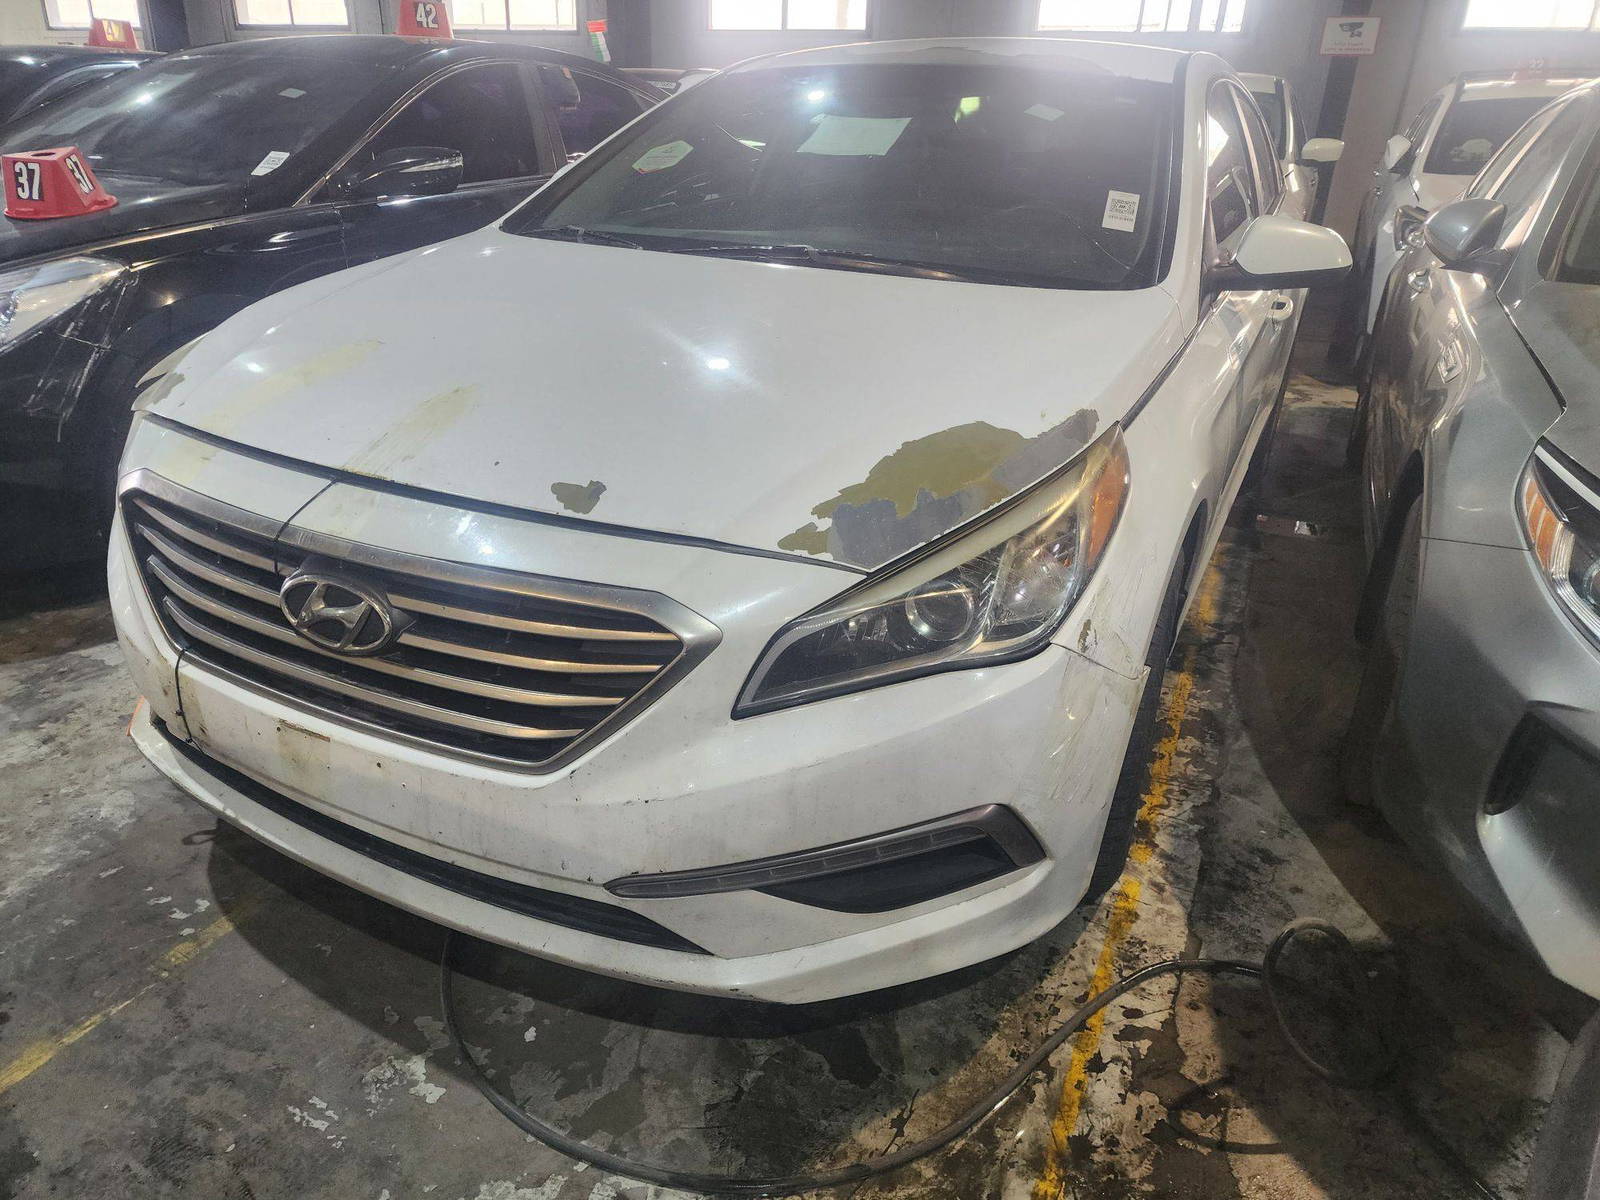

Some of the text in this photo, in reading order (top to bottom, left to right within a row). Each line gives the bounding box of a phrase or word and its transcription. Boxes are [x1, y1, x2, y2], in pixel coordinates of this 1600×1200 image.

[416, 2, 439, 28] 42
[14, 161, 41, 200] 37
[65, 154, 94, 194] 37
